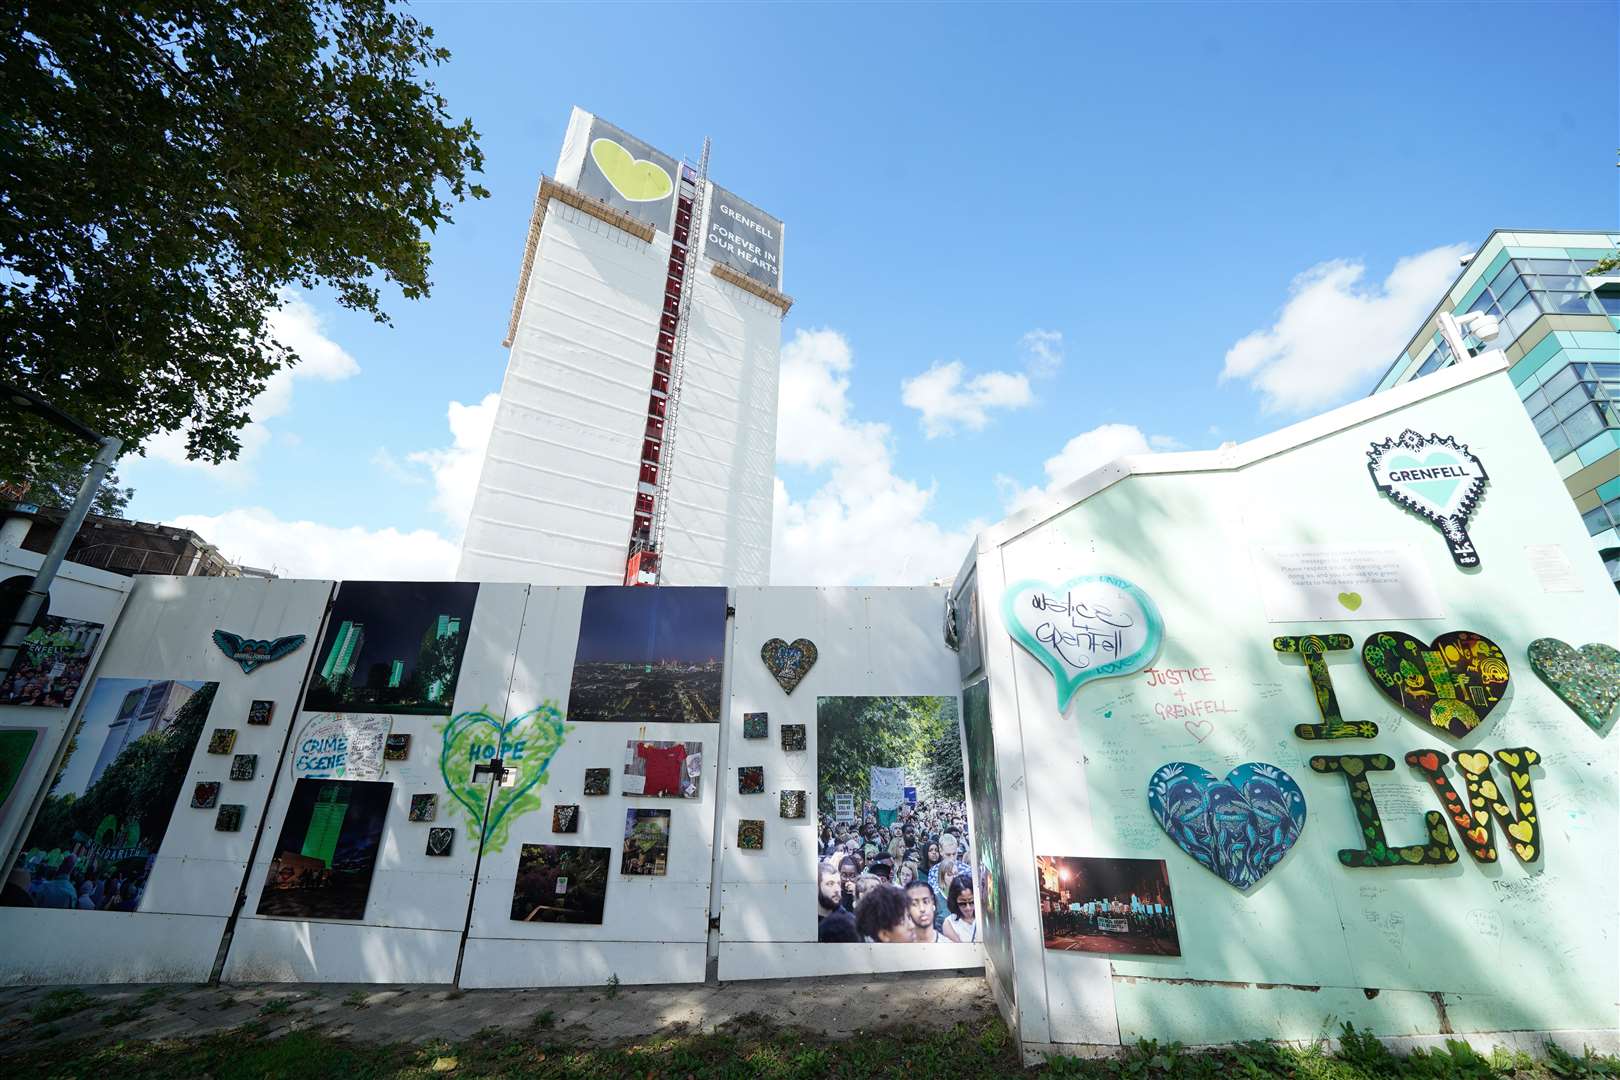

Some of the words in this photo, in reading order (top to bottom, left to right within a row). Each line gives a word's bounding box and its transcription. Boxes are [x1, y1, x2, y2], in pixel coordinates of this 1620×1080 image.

[720, 204, 774, 240] GRENFELL
[713, 223, 762, 256] FOREVER
[764, 251, 776, 263] IN
[708, 233, 735, 254] OUR
[737, 248, 778, 275] HEARTS
[1388, 465, 1471, 483] GRENFELL
[1144, 667, 1216, 687] JUSTICE
[1155, 699, 1239, 720] GRENFELL
[302, 737, 348, 753] CRIME
[469, 740, 527, 762] HOPE
[296, 753, 347, 770] SCENE
